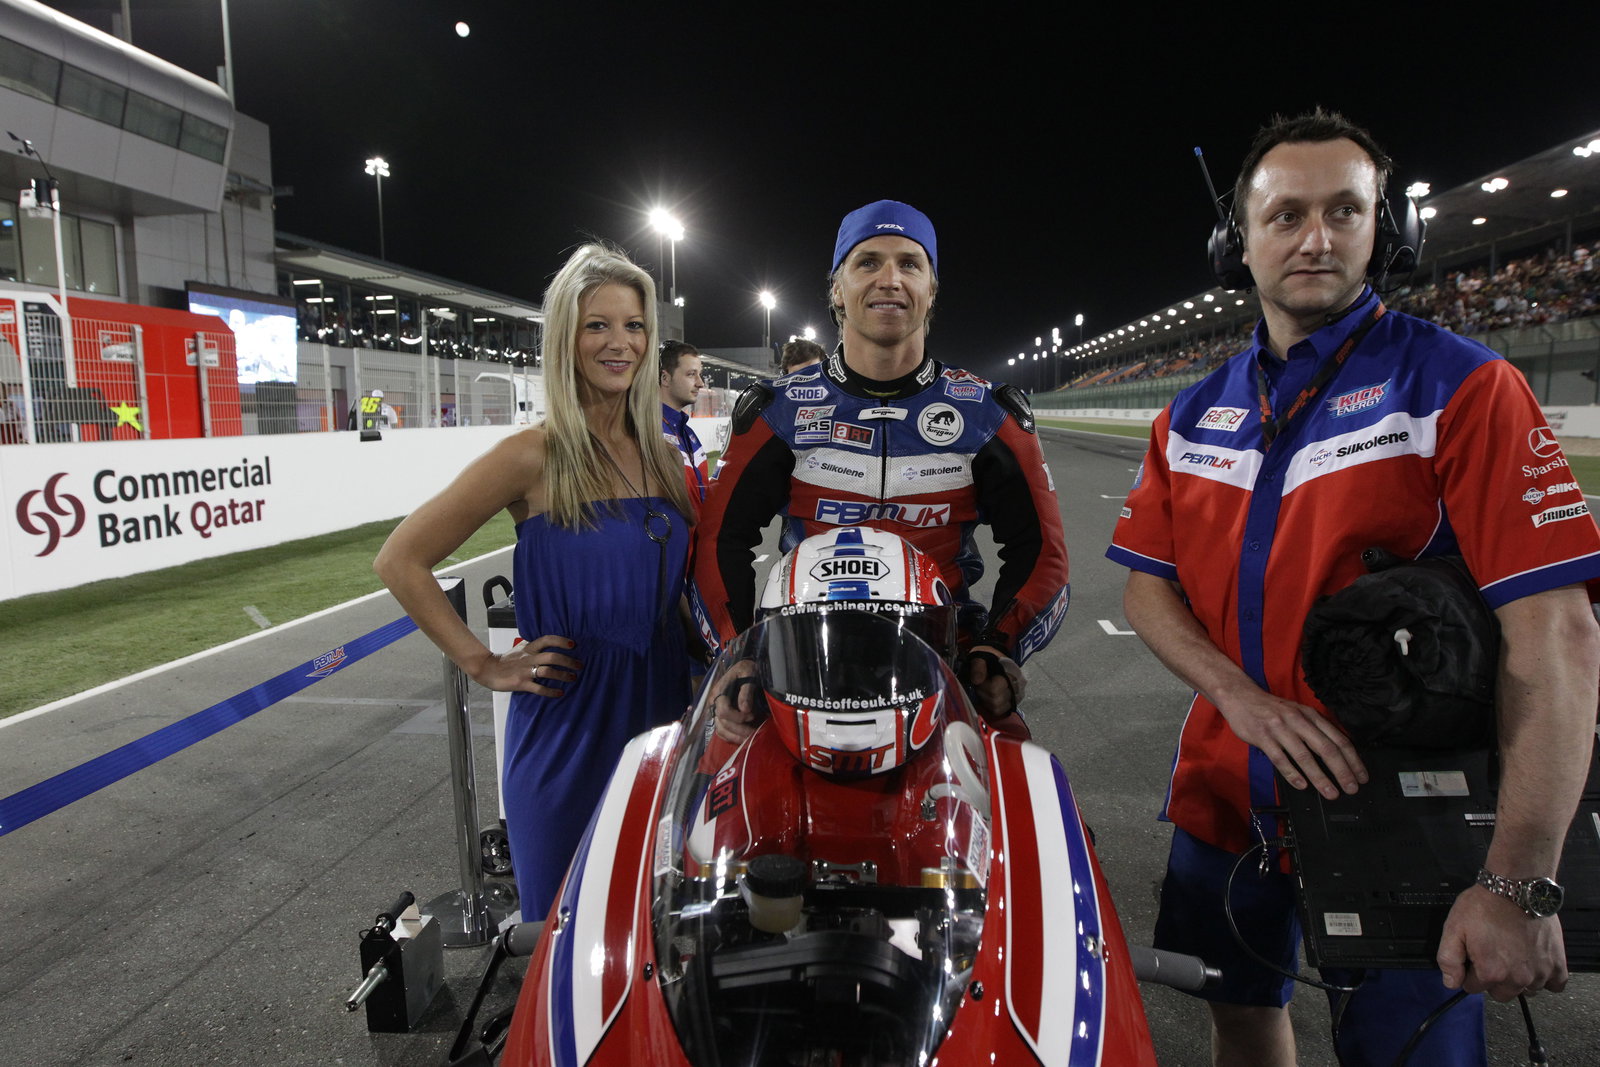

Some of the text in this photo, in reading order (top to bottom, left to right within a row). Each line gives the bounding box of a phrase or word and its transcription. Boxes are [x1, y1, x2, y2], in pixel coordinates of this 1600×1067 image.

[790, 388, 824, 399] SHOEI
[1337, 380, 1389, 407] KICK
[1337, 395, 1382, 416] ENERGY
[1202, 409, 1245, 425] Rapid
[1309, 431, 1409, 464] FUCHS Silkolene
[820, 462, 865, 479] Silkolene
[920, 465, 963, 477] Silkolene
[1179, 452, 1238, 470] PBMUK
[1521, 456, 1569, 479] Sparsh
[93, 456, 272, 504] Commercial
[1523, 491, 1545, 500] FUCHS
[98, 499, 266, 548] Bank Qatar
[817, 499, 949, 527] PBMUK
[820, 559, 880, 578] SHOEI
[785, 688, 924, 710] xpresscoffeeuk.co.uk
